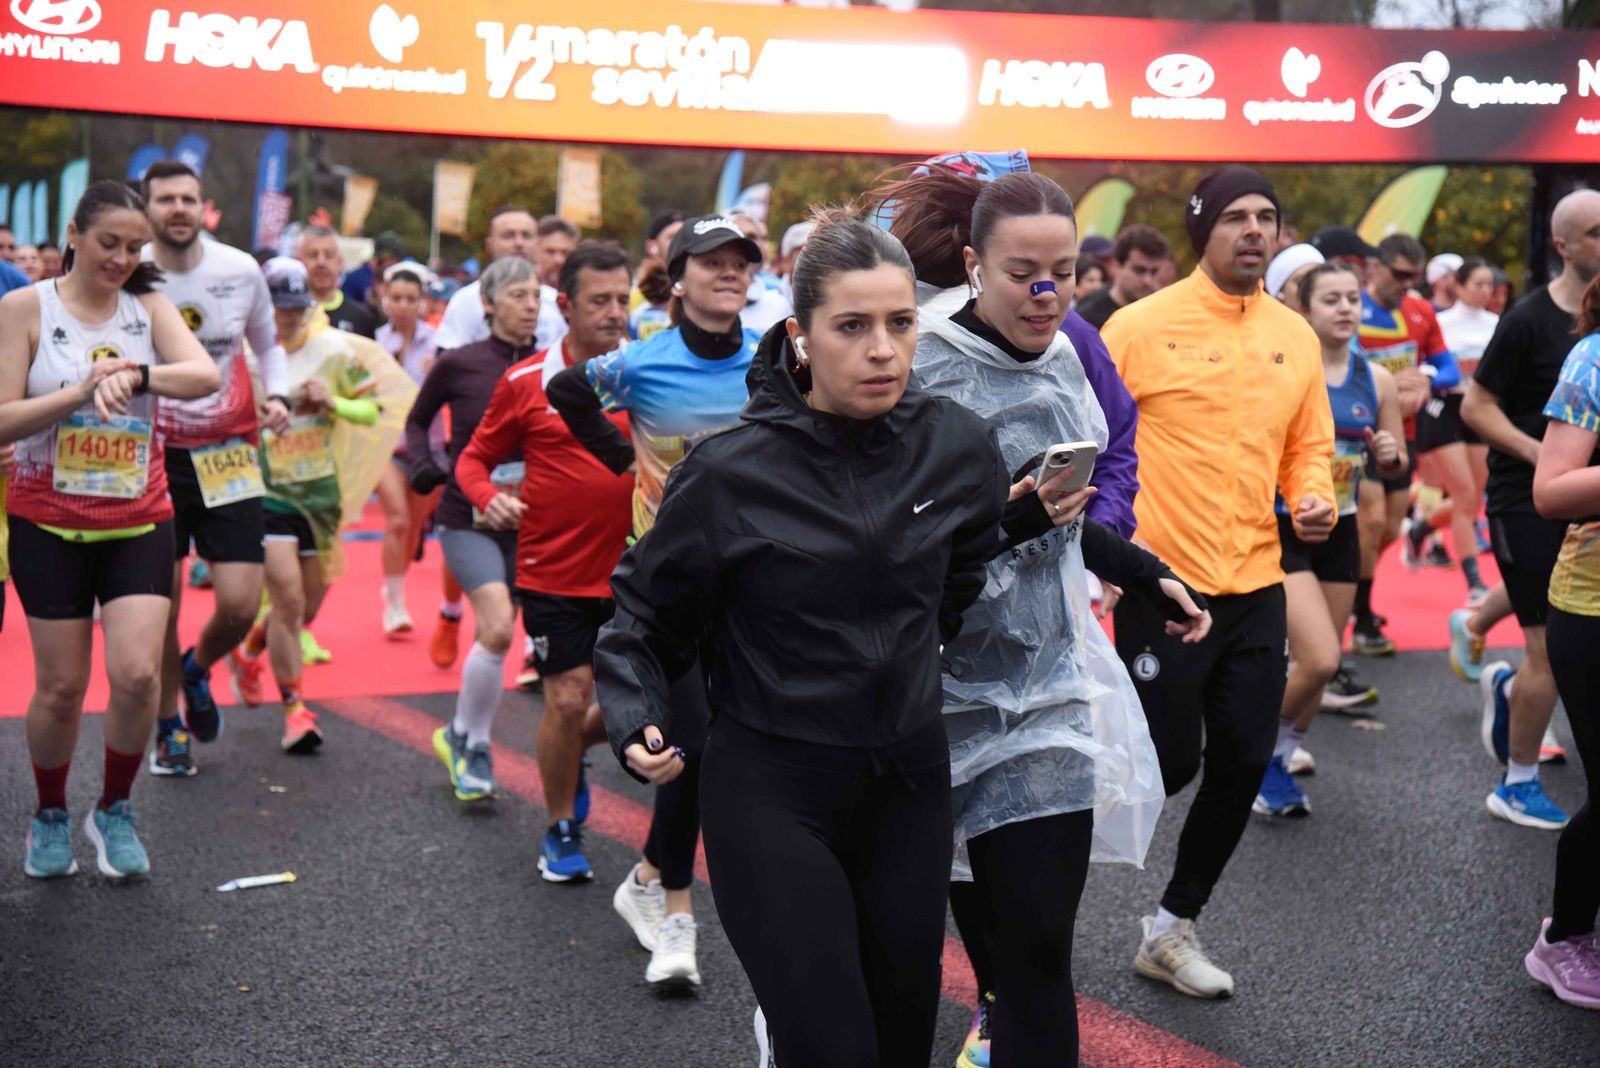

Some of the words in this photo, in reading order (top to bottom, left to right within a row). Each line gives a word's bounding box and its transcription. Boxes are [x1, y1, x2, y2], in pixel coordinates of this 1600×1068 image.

[145, 9, 315, 73] HOKA
[978, 59, 1111, 108] HOKA
[66, 432, 137, 463] 14018
